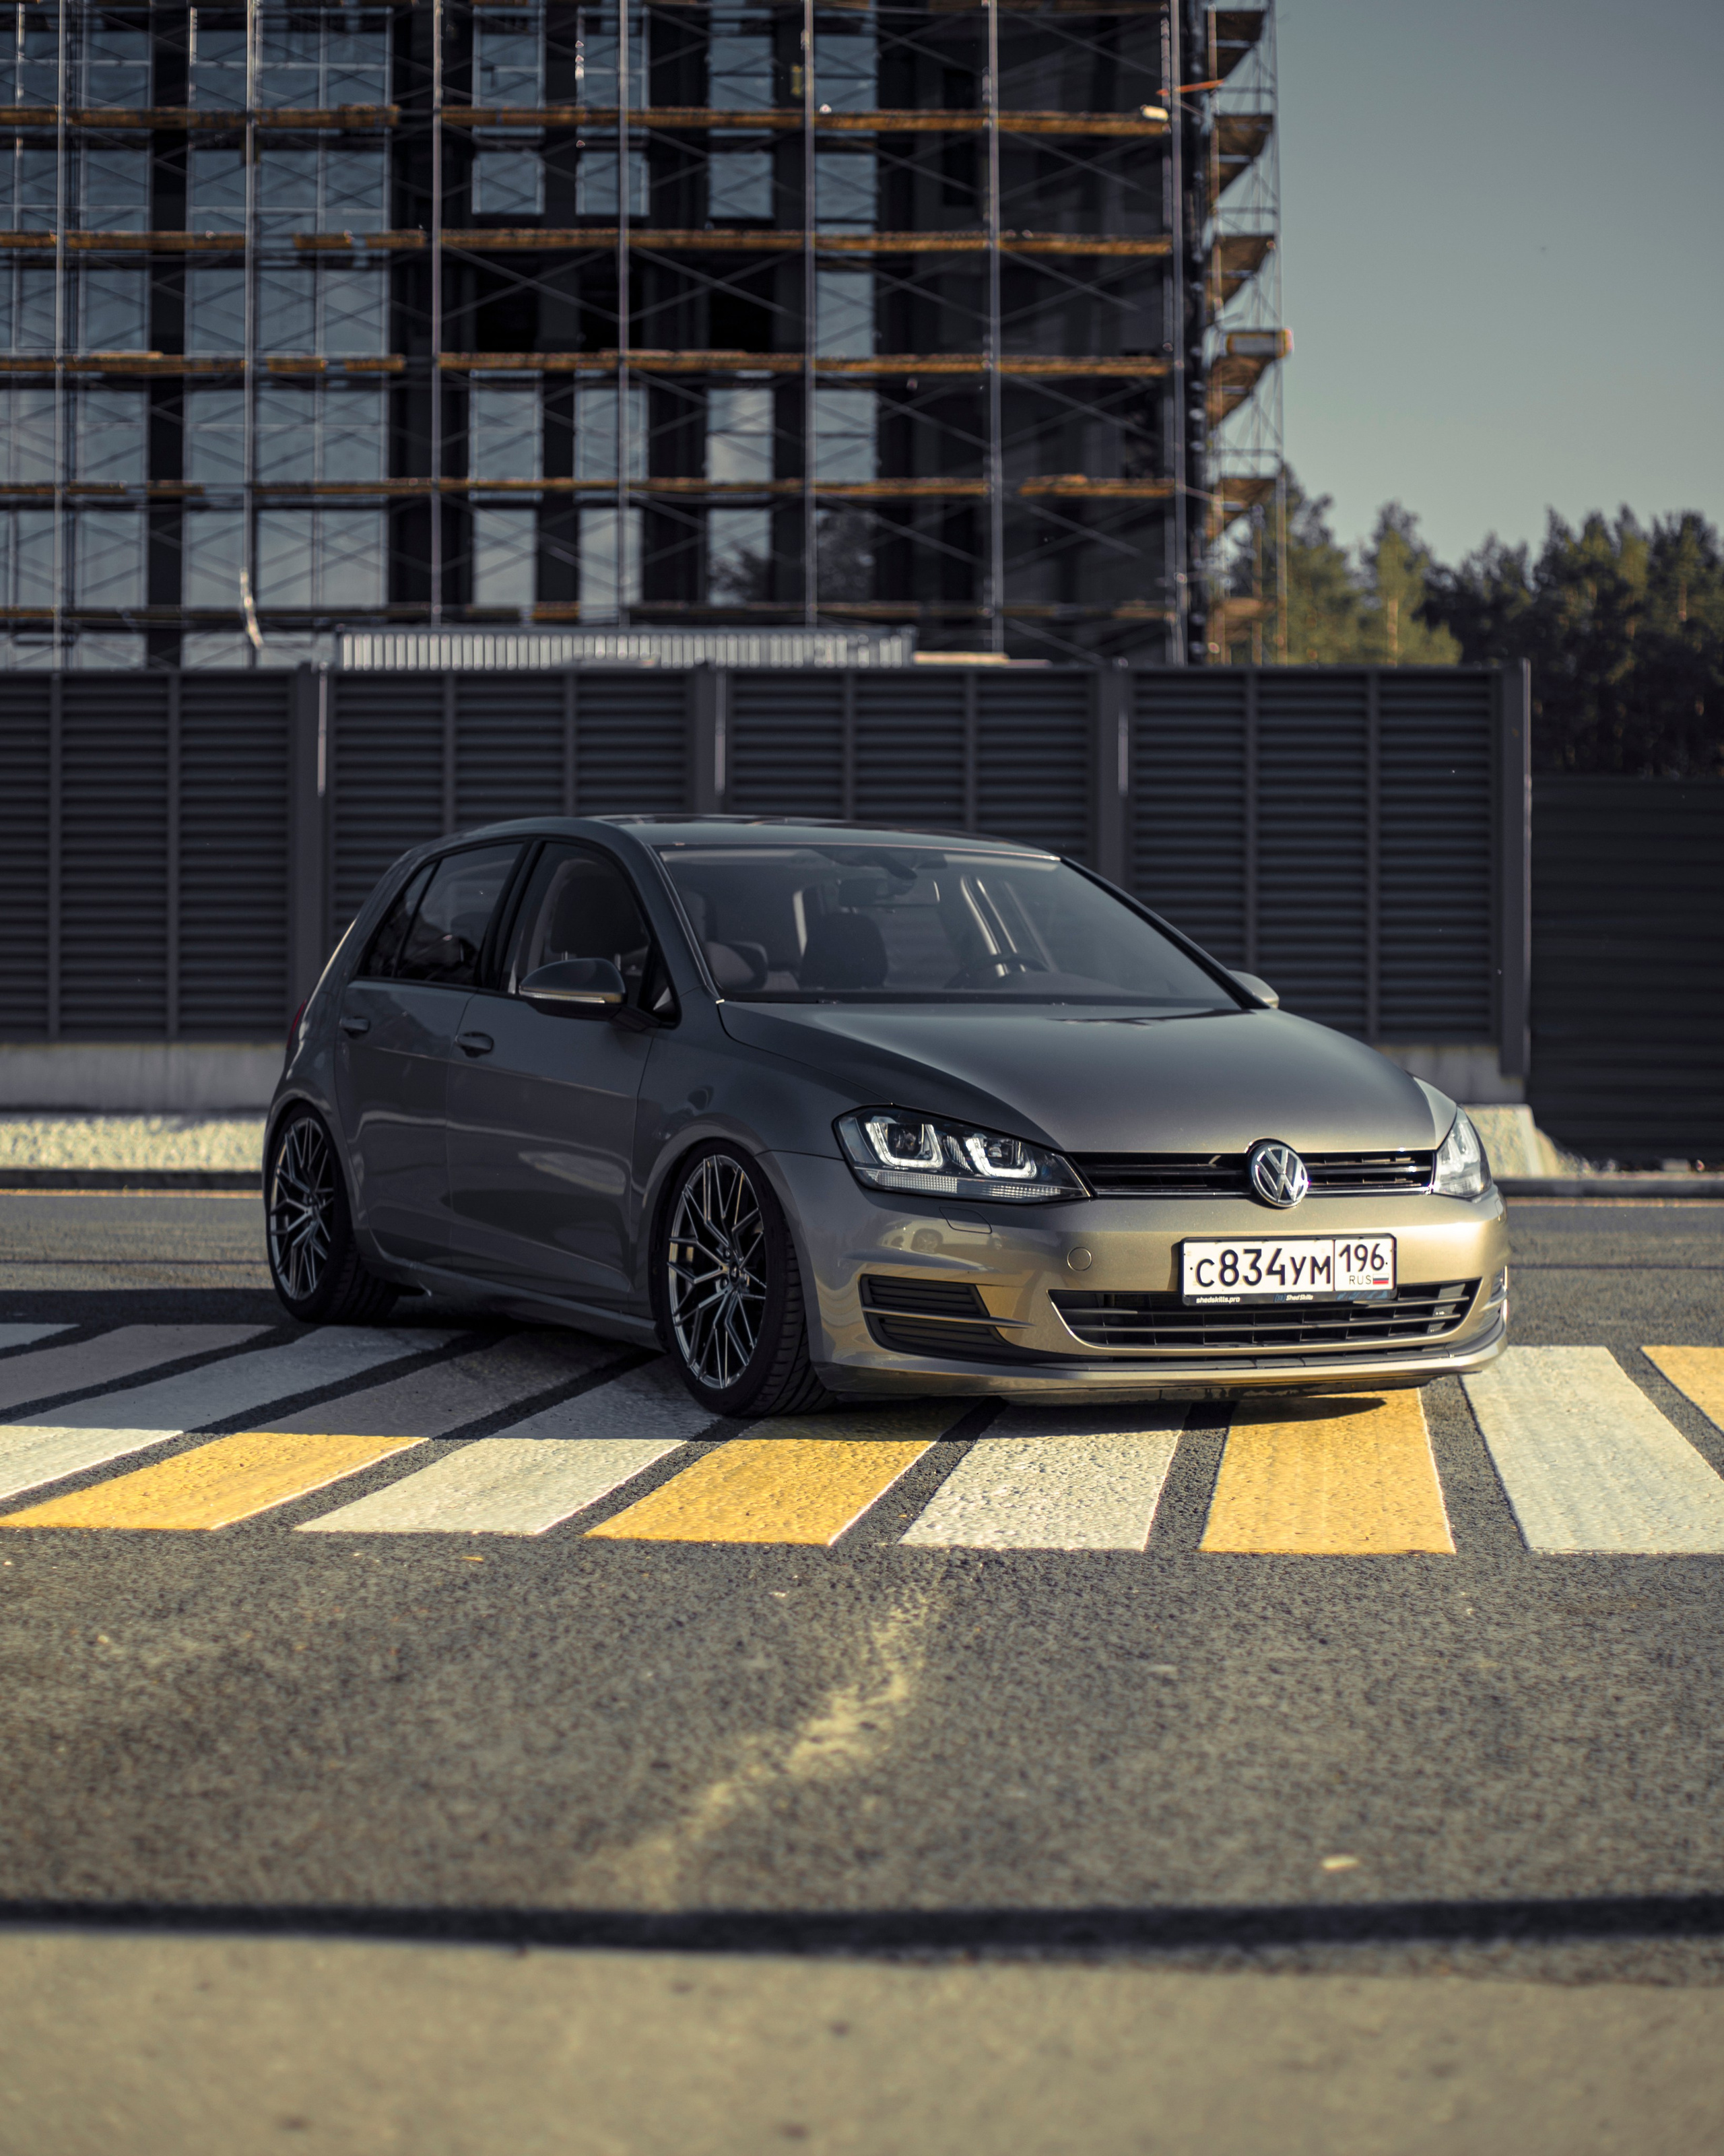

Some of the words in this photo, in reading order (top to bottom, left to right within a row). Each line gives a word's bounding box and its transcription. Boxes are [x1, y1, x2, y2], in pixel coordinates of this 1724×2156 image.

[1339, 1243, 1385, 1272] 196
[1349, 1275, 1372, 1285] RUS
[1196, 1296, 1240, 1304] shedskills.pro
